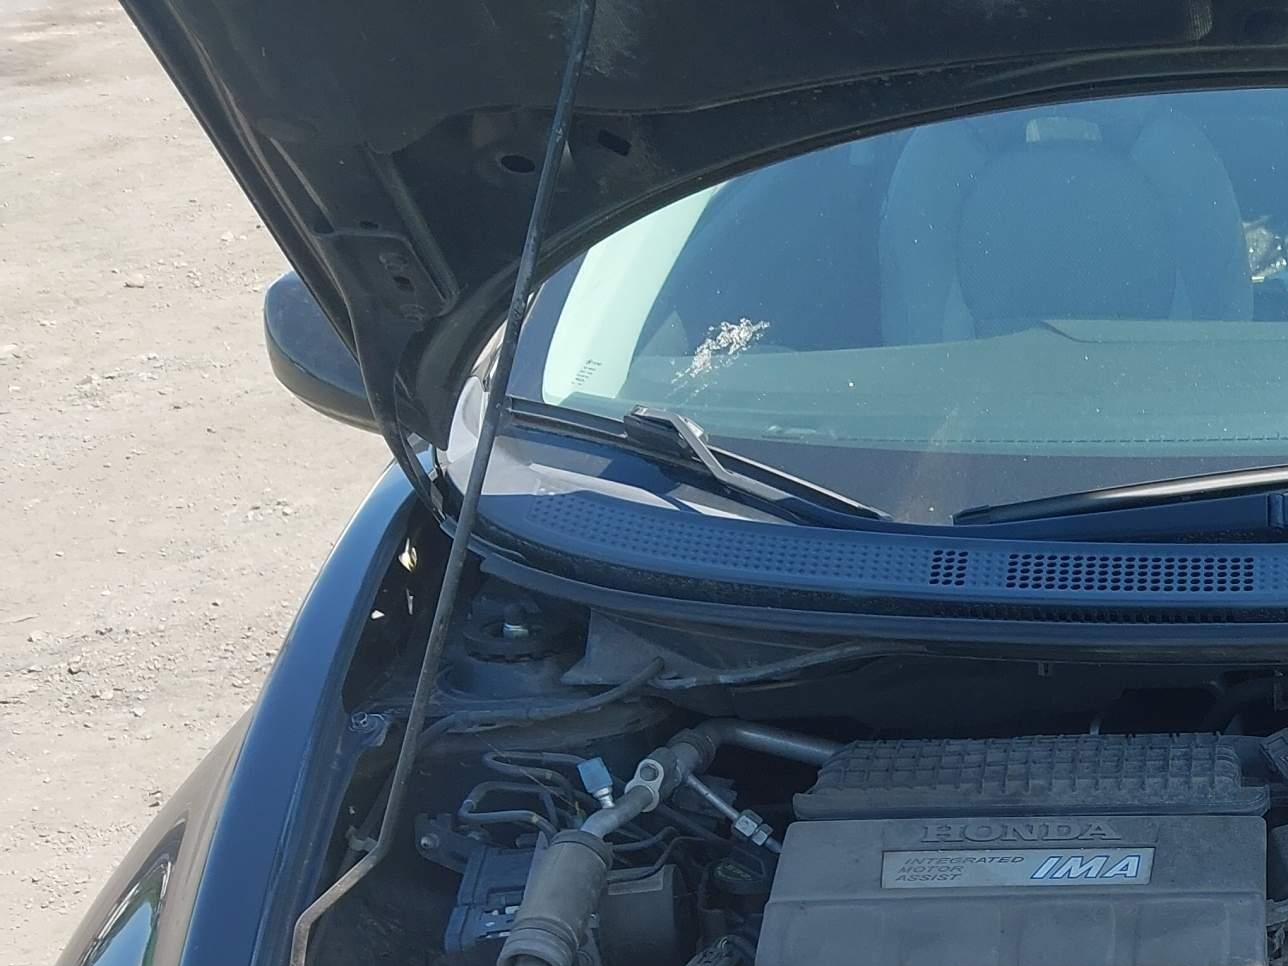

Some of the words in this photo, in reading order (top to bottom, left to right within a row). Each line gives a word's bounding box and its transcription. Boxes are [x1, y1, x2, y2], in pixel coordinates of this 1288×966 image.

[921, 823, 1121, 843] HONDA
[897, 865, 964, 874] MOTOR
[904, 856, 1025, 864] INTEGRATED
[1030, 855, 1141, 880] IMA
[895, 874, 962, 882] ASSIST
